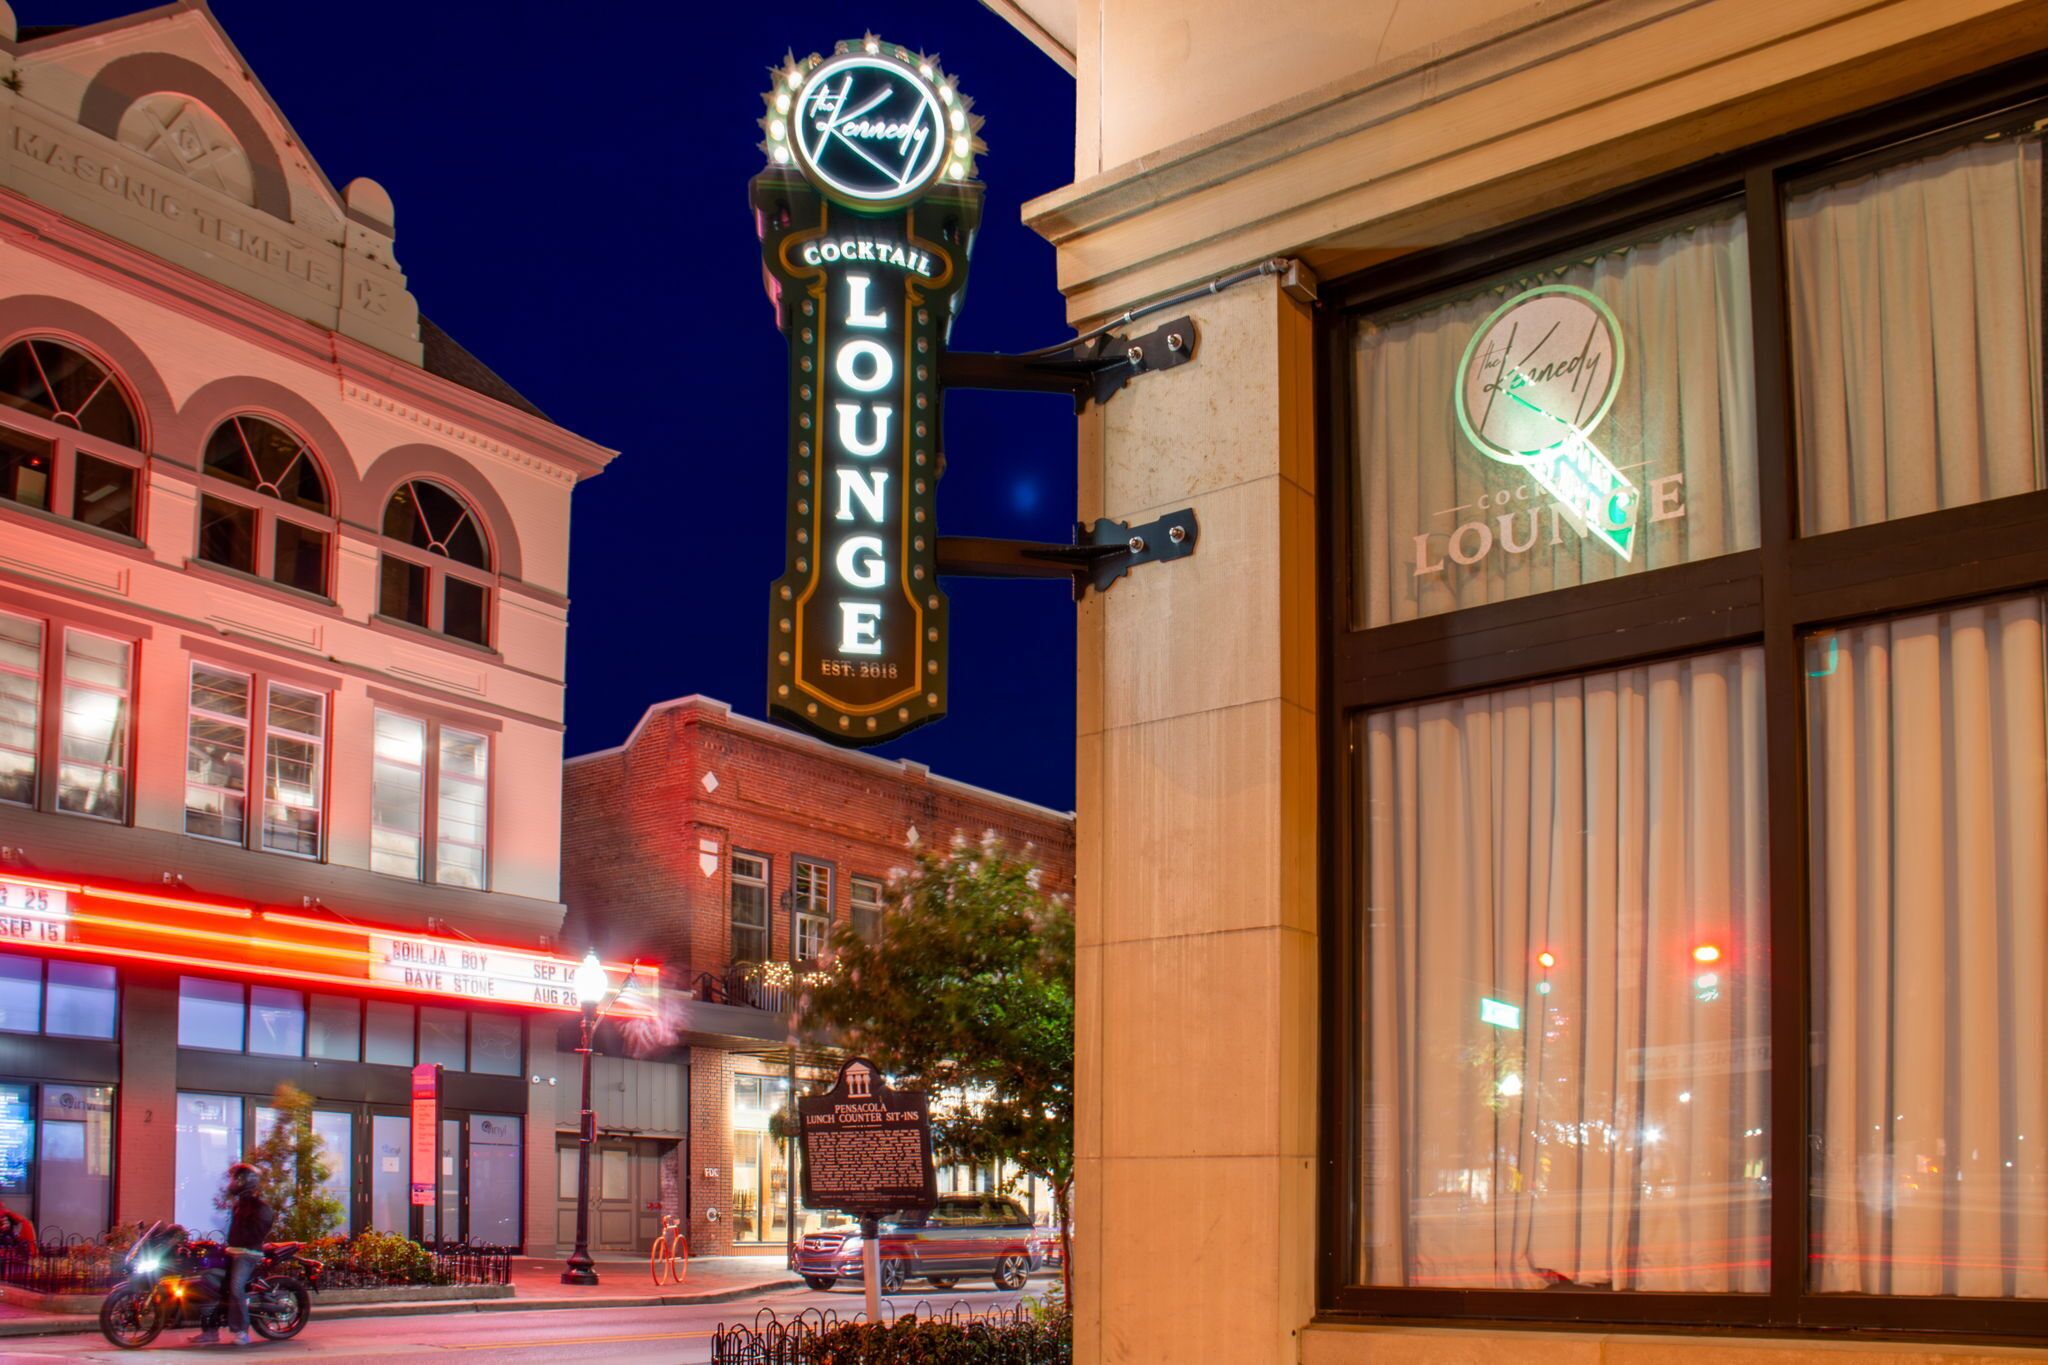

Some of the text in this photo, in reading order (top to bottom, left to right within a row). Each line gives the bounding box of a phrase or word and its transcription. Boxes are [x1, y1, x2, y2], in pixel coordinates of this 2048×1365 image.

[808, 84, 847, 118] the
[812, 75, 930, 188] Kennedy
[14, 126, 181, 222] MASONIC
[803, 241, 931, 277] COCKTAIL
[835, 275, 893, 655] LOUNGE
[860, 662, 898, 679] 2018
[25, 887, 49, 911] 25
[40, 922, 58, 942] 15
[462, 950, 488, 971] BOY
[533, 961, 556, 980] SEP
[404, 967, 578, 1006] DAVE STONE AUG 26
[806, 1111, 919, 1125] LUNCH COUNTER SIT-INS
[834, 1103, 887, 1114] PENSACOLA
